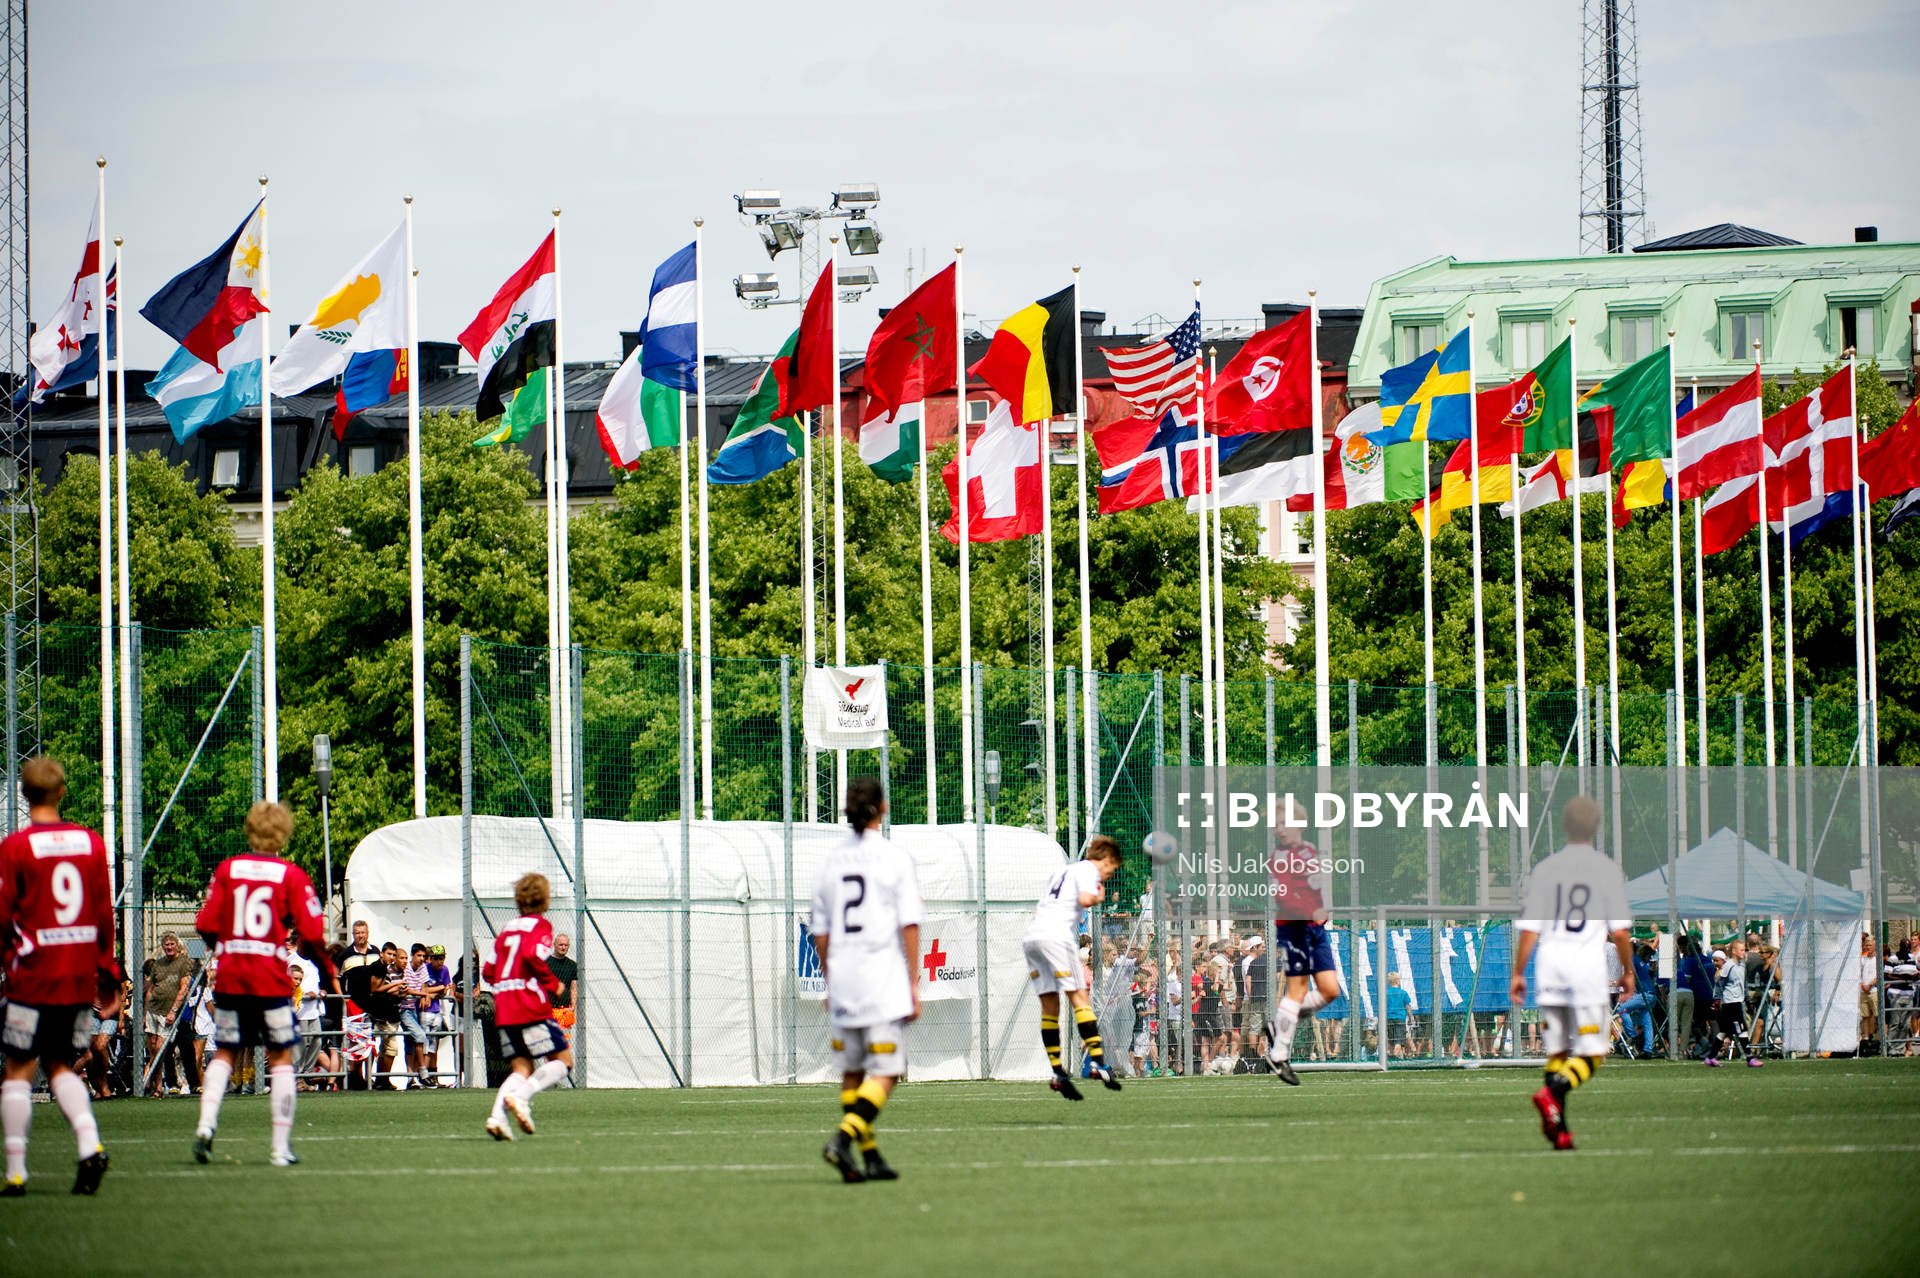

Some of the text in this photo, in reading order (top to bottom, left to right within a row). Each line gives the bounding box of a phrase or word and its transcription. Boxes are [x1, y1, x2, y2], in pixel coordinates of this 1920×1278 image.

[52, 861, 83, 926] 9
[232, 884, 273, 938] 16
[842, 874, 865, 933] 2
[1553, 883, 1591, 932] 18
[501, 934, 521, 978] 7
